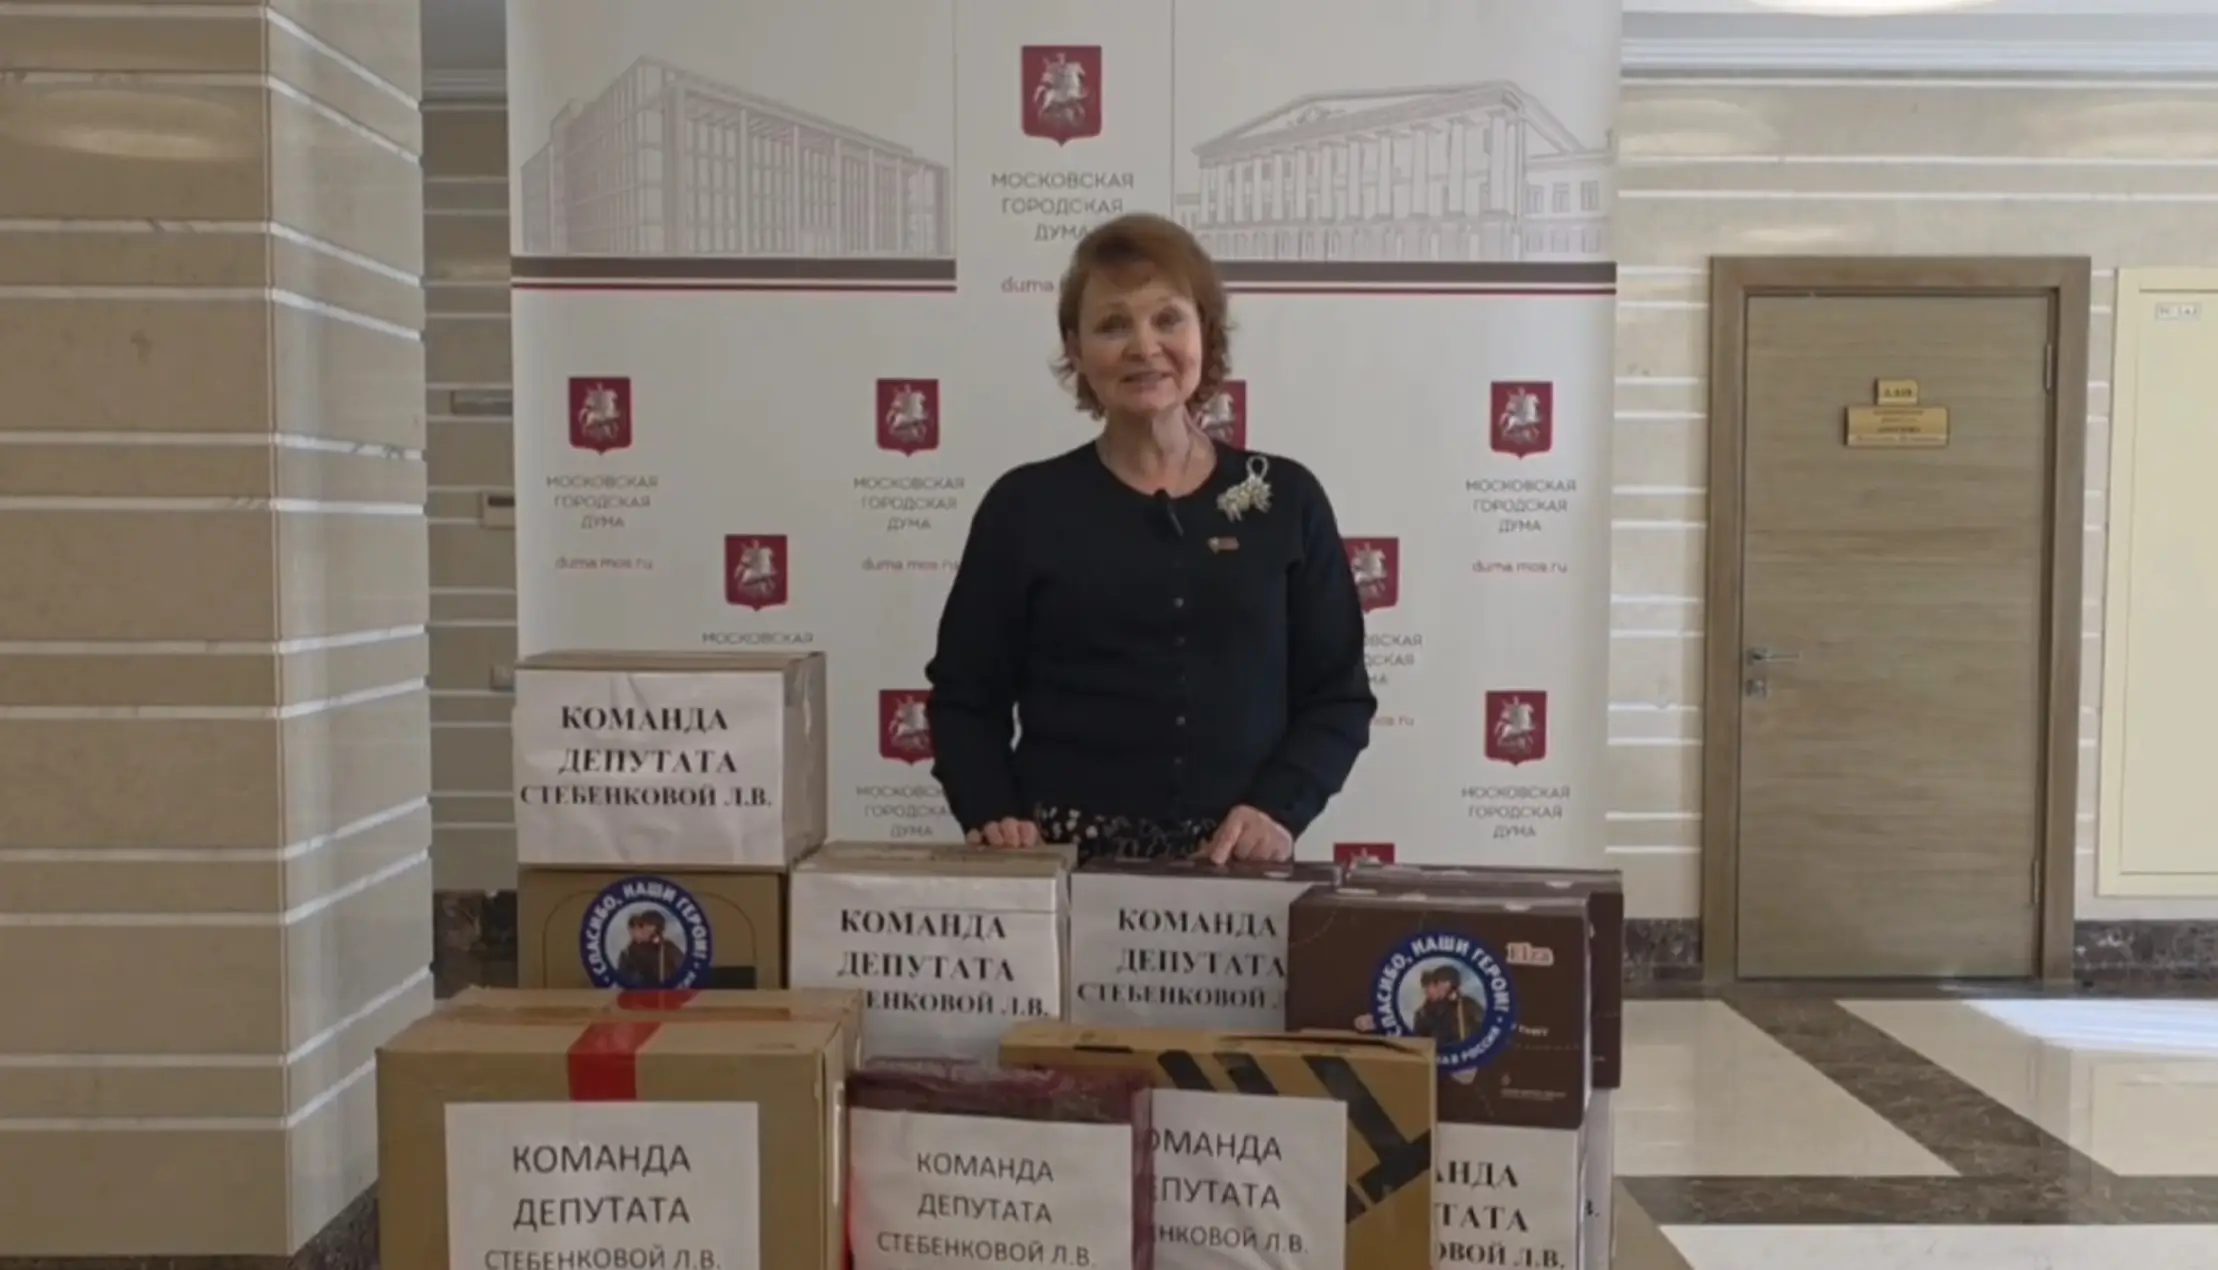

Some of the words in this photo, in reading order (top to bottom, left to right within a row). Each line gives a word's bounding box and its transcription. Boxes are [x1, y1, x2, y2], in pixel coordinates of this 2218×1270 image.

[991, 172, 1134, 189] МОСКОВСКАЯ
[1002, 198, 1124, 216] ГОРОДСКАЯ
[1034, 224, 1089, 241] ДУМА
[546, 475, 659, 488] МОСКОВСКАЯ
[853, 476, 965, 490] МОСКОВСКАЯ
[1465, 479, 1577, 492] МОСКОВСКАЯ
[554, 495, 651, 509] ГОРОДСКАЯ
[861, 496, 958, 511] ГОРОДСКАЯ
[1473, 499, 1568, 512] ГОРОДСКАЯ
[581, 516, 625, 529] ДУМА
[887, 517, 932, 531] ДУМА
[1498, 519, 1542, 533] ДУМА
[702, 632, 815, 645] МОСКОВСКАЯ
[561, 706, 729, 733] КОМАНДА
[558, 749, 738, 775] ДЕПУТАТА
[520, 784, 716, 807] СТЕБЕНКОВОЙ
[724, 789, 773, 809] Л.В.
[1461, 784, 1571, 799] МОСКОВСКАЯ
[1468, 804, 1563, 819] ГОРОДСКАЯ
[890, 824, 933, 838] ДУМА
[1493, 824, 1537, 839] ДУМА
[622, 882, 678, 901] НАШИ
[841, 909, 1007, 941] КОМАНДА
[1118, 908, 1278, 938] КОМАНДА
[836, 950, 1015, 981] ДЕПУТАТА
[1116, 948, 1286, 978] ДЕПУТАТА
[1410, 935, 1471, 957] НАШИ
[1470, 948, 1510, 1012] ГЕРОИ!
[866, 990, 994, 1014] ЕНКОВОЙ
[1001, 997, 1049, 1017] Л.В.
[1077, 983, 1265, 1009] СТЕБЕНКОВОЙ
[1144, 1128, 1283, 1165] ОМАНДА
[512, 1144, 691, 1175] КОМАНДА
[917, 1152, 1054, 1184] КОМАНДА
[513, 1196, 690, 1231] ДЕПУТАТА
[917, 1193, 1052, 1224] ДЕПУТАТА
[1434, 1203, 1530, 1233] ТАТА
[877, 1232, 1046, 1264] СТЕБЕНКОВОЙ
[1052, 1243, 1096, 1268] Л.В.
[1159, 1223, 1258, 1249] НКОВОЙ
[1264, 1233, 1309, 1255] Л.В.
[484, 1244, 665, 1270] СТЕБЕНКОВОЙ
[674, 1250, 721, 1270] Л.В.
[1513, 1248, 1566, 1269] Л.В.
